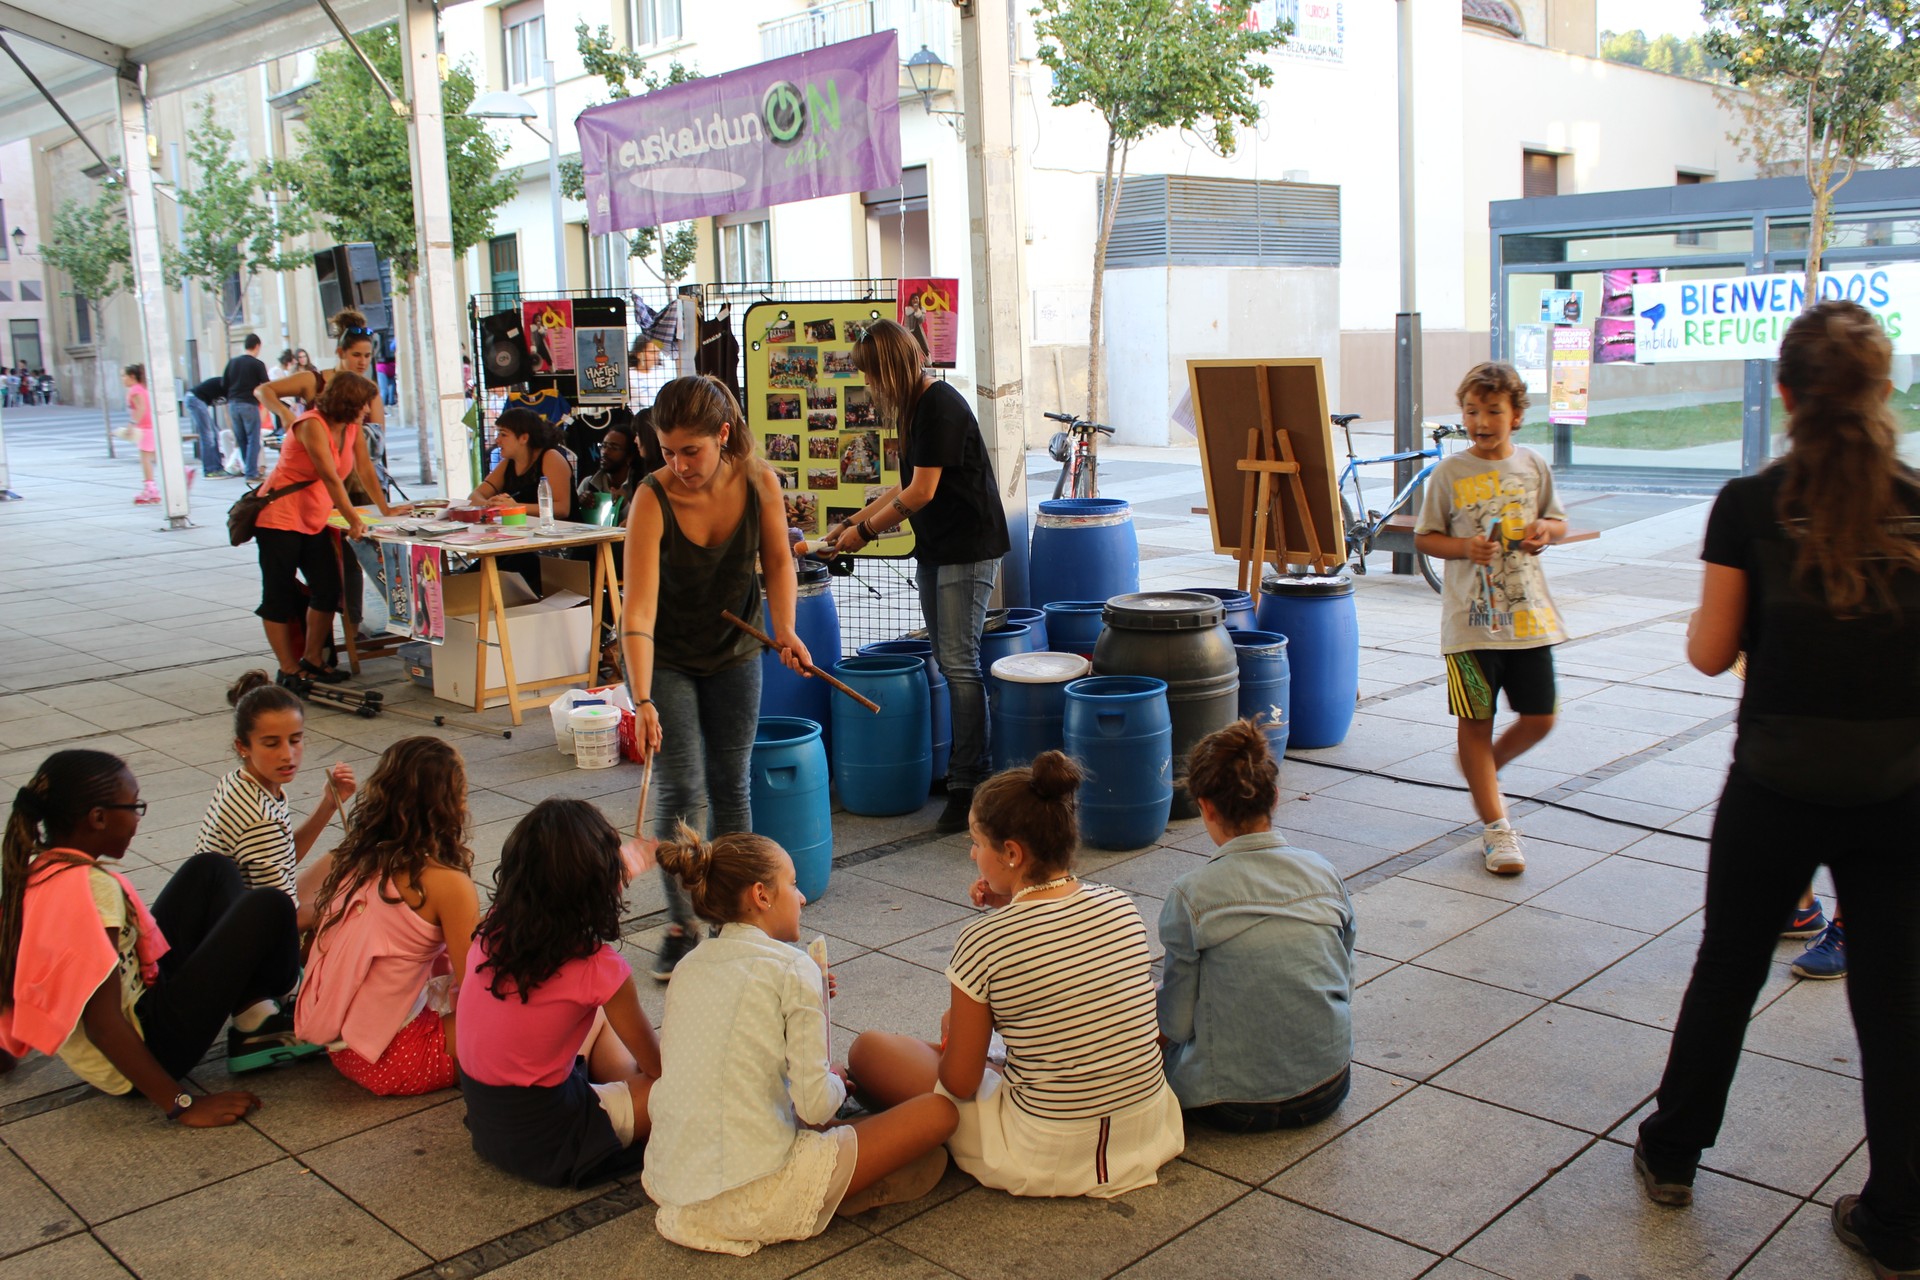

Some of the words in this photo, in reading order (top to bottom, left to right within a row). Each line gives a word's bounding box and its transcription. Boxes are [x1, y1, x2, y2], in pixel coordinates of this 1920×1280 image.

[1684, 312, 1902, 346] REFUGIS
[592, 377, 616, 388] HEZI
[1468, 613, 1513, 627] FRIEDLY
